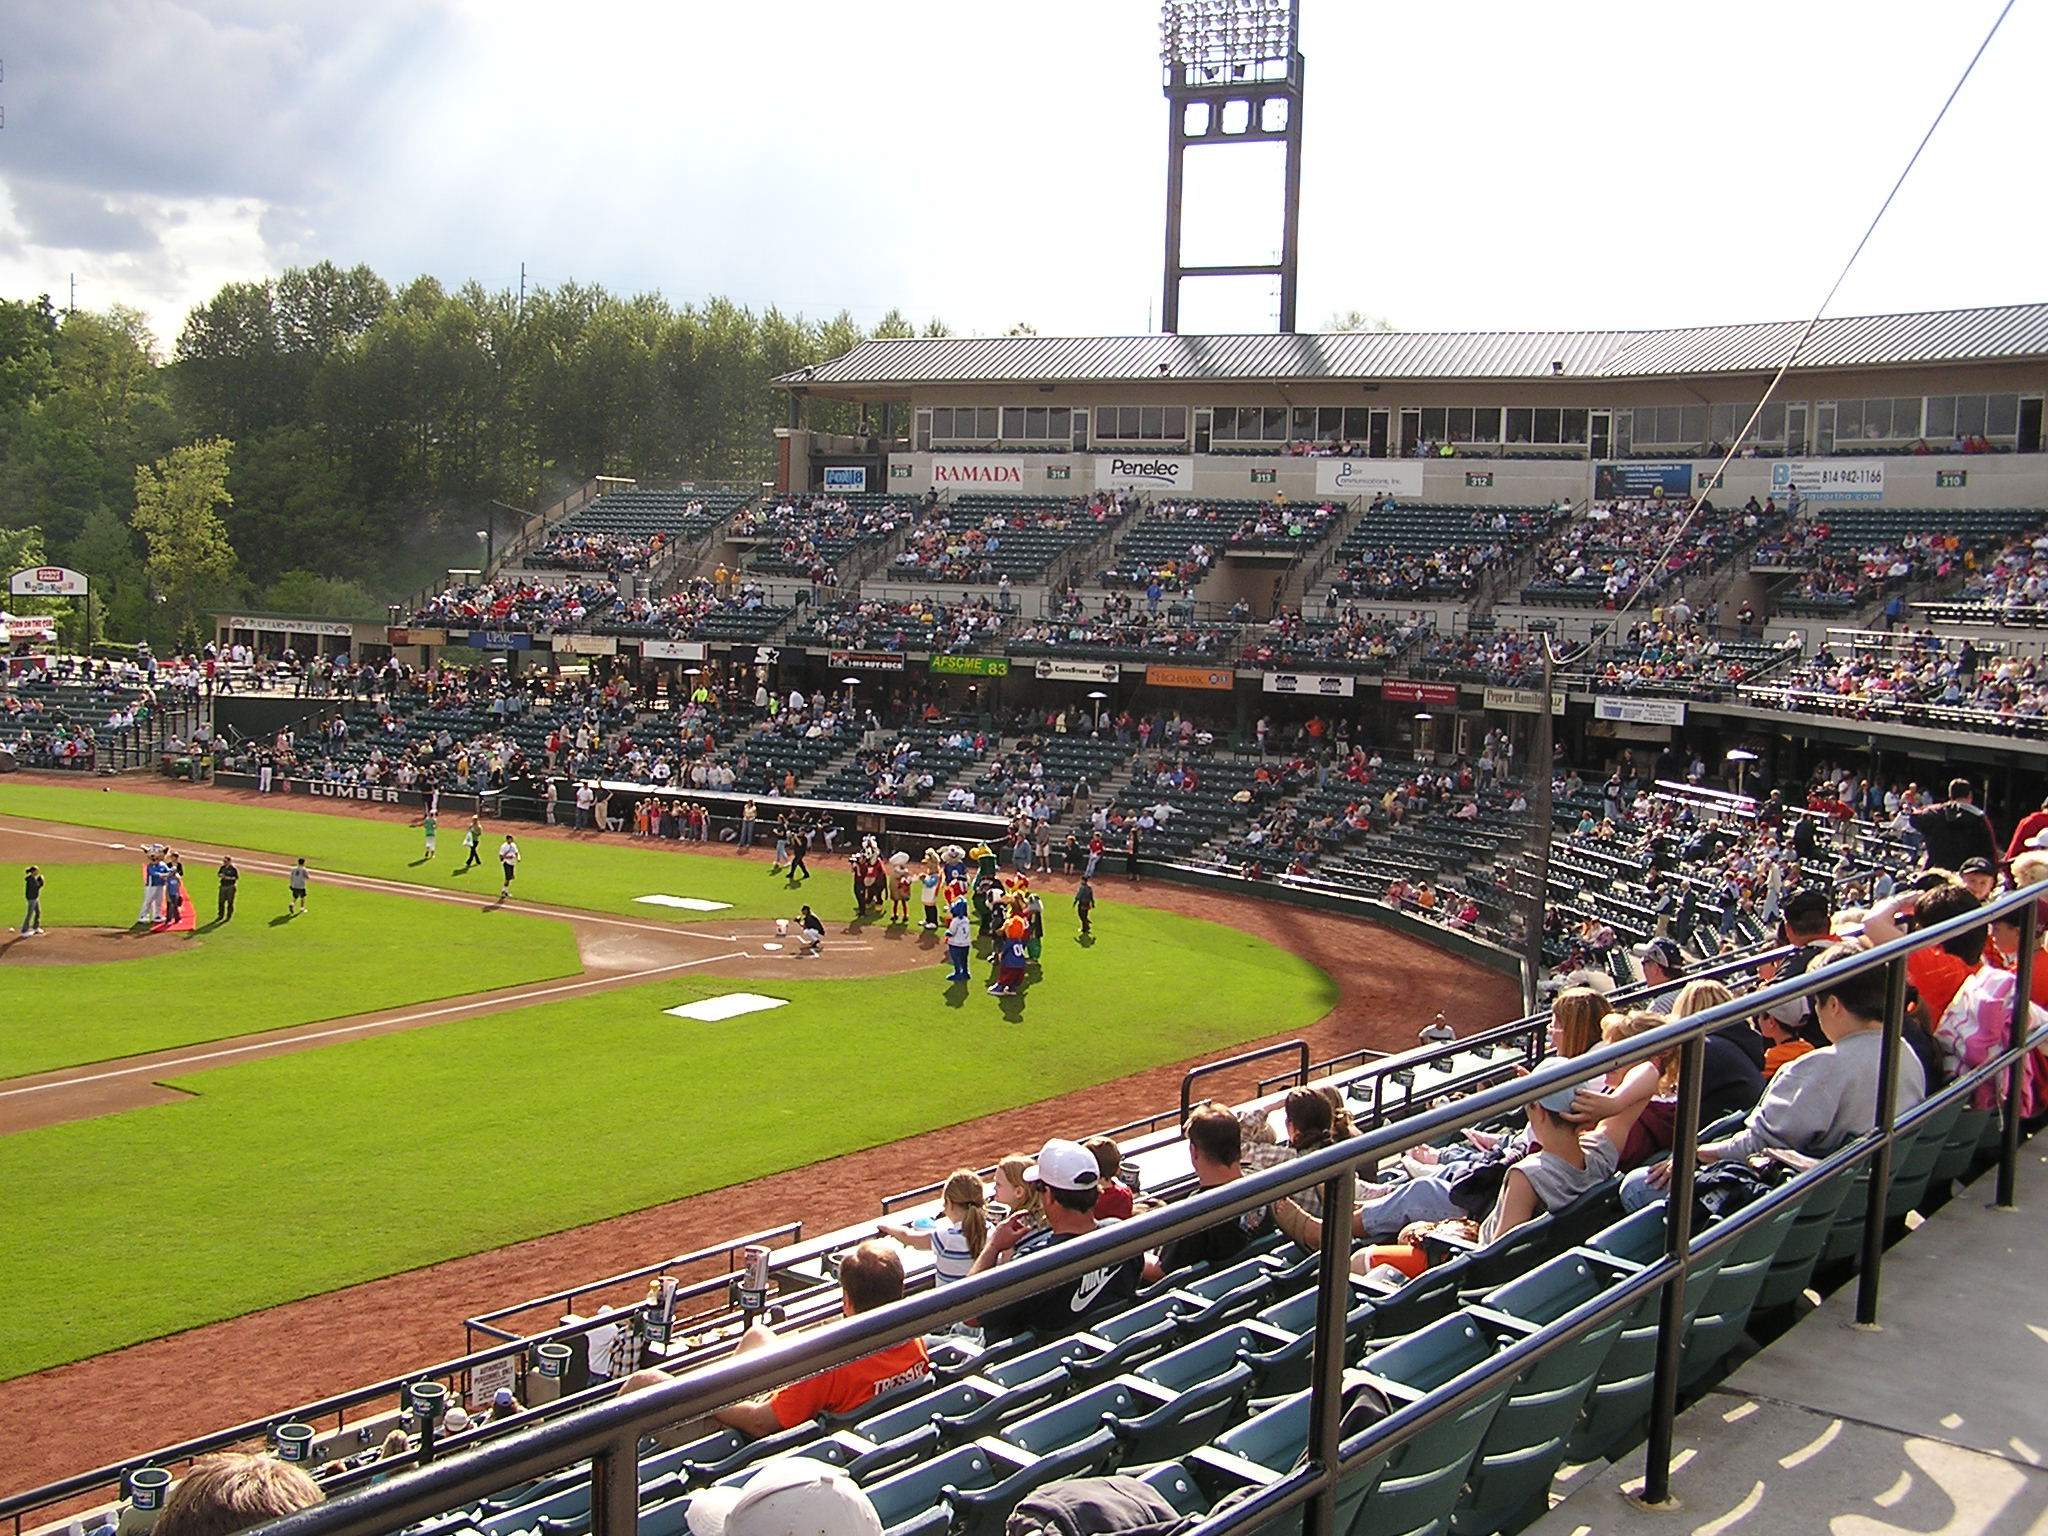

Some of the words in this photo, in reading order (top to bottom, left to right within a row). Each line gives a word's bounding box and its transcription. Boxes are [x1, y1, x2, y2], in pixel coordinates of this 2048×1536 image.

[935, 466, 1021, 482] RAMADA
[1112, 459, 1179, 476] Penelec
[1051, 472, 1066, 480] 314
[1256, 474, 1271, 482] 313
[1471, 478, 1488, 487] 312
[1822, 470, 1839, 484] 814
[1841, 470, 1883, 484] 942-1166
[1943, 477, 1961, 486] 310
[486, 632, 514, 644] UPMC
[932, 656, 983, 669] AFSCME
[988, 663, 1008, 676] 83
[1487, 690, 1512, 705] Pepper
[310, 783, 399, 803] LUMBER
